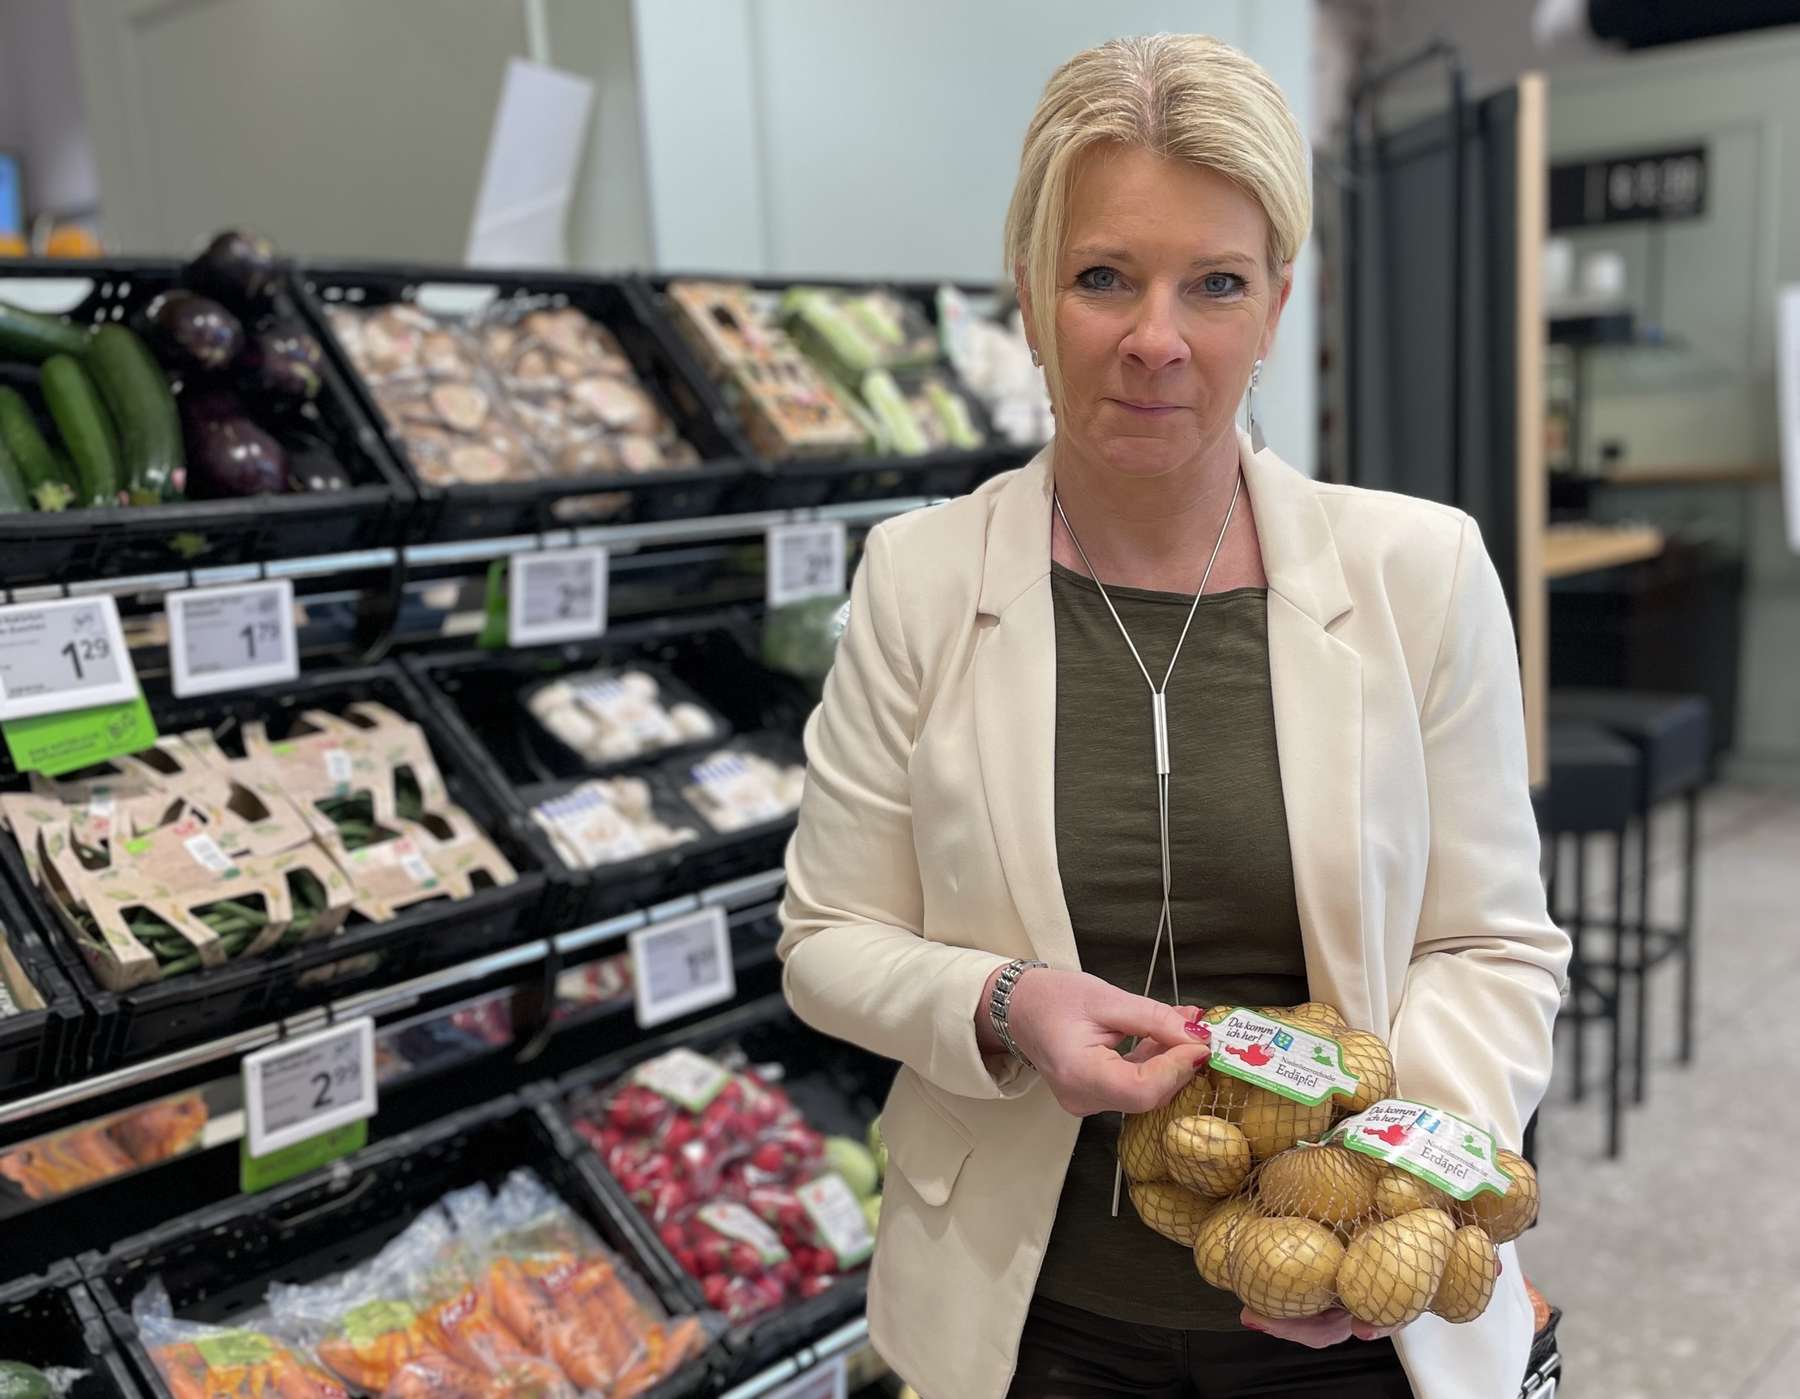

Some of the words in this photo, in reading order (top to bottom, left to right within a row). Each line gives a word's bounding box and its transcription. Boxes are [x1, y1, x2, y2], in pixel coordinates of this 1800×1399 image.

[1226, 1028, 1241, 1039] ich
[1241, 1031, 1263, 1042] her!
[1275, 1063, 1319, 1088] Erdäpfel
[1420, 1145, 1469, 1179] Erdäpfel
